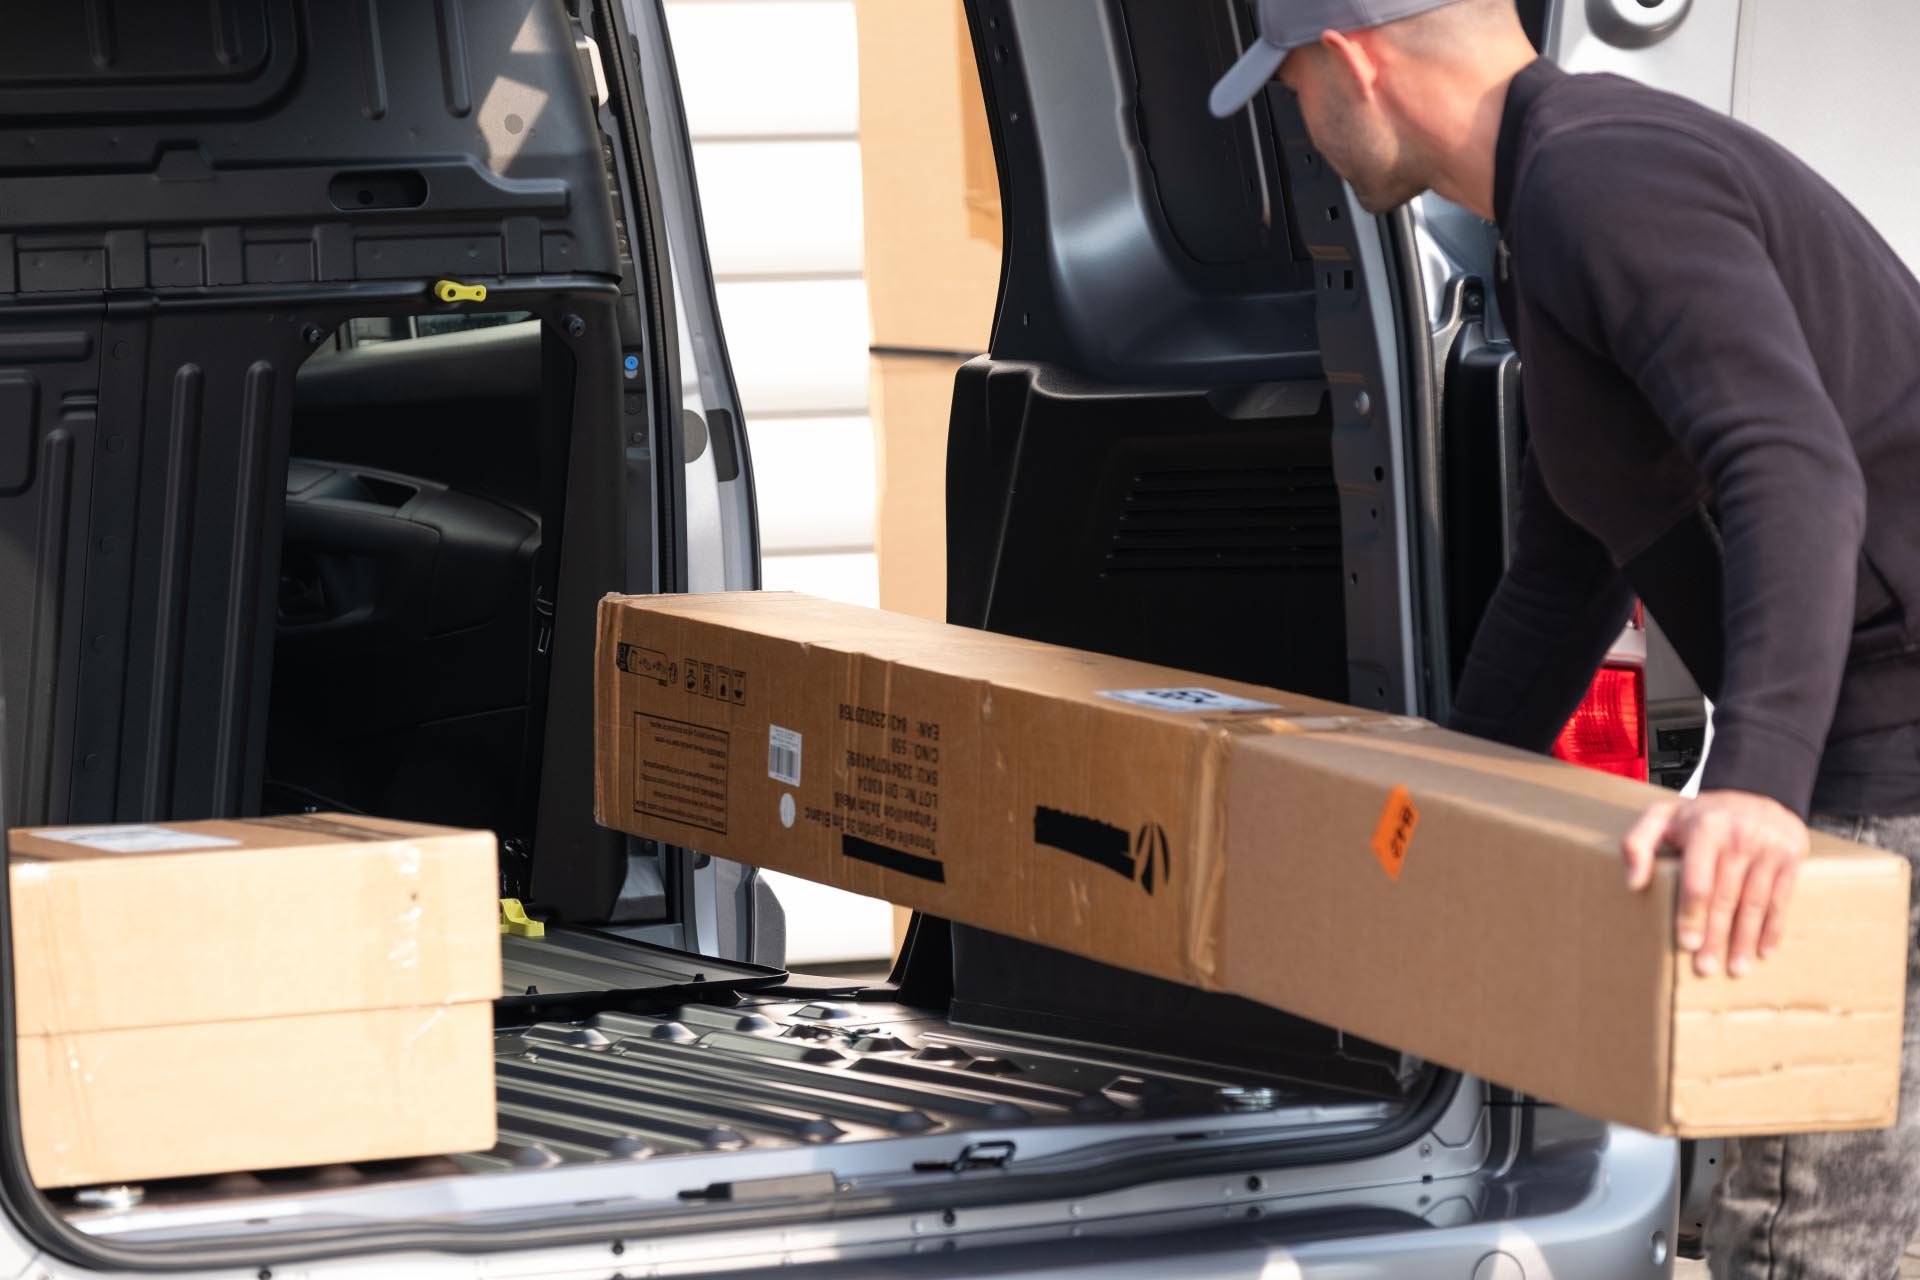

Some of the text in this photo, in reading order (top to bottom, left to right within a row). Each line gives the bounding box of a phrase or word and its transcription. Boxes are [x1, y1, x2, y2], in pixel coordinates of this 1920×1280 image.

[919, 791, 938, 809] LOT
[804, 806, 831, 828] Blanc
[885, 826, 897, 841] de
